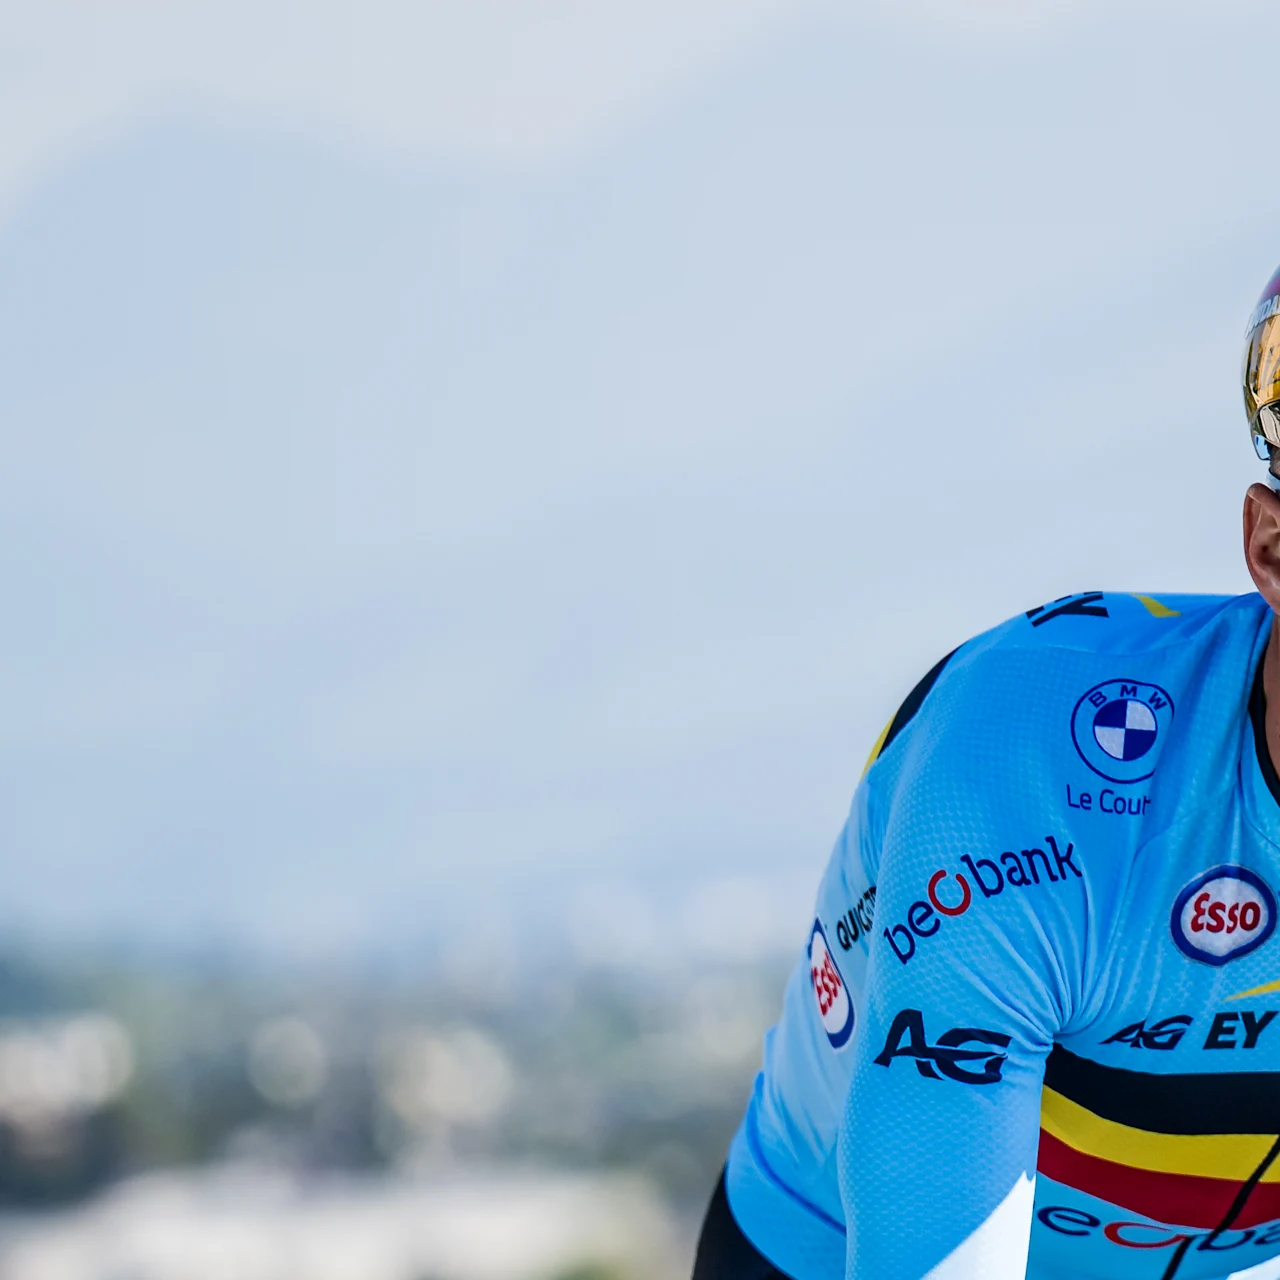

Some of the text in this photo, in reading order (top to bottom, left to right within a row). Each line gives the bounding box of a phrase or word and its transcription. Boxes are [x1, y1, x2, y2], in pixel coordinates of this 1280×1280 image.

[1088, 684, 1167, 711] BMW
[1066, 783, 1092, 811] Le
[873, 1009, 1013, 1086] AG
[1100, 1010, 1280, 1051] AG EY
